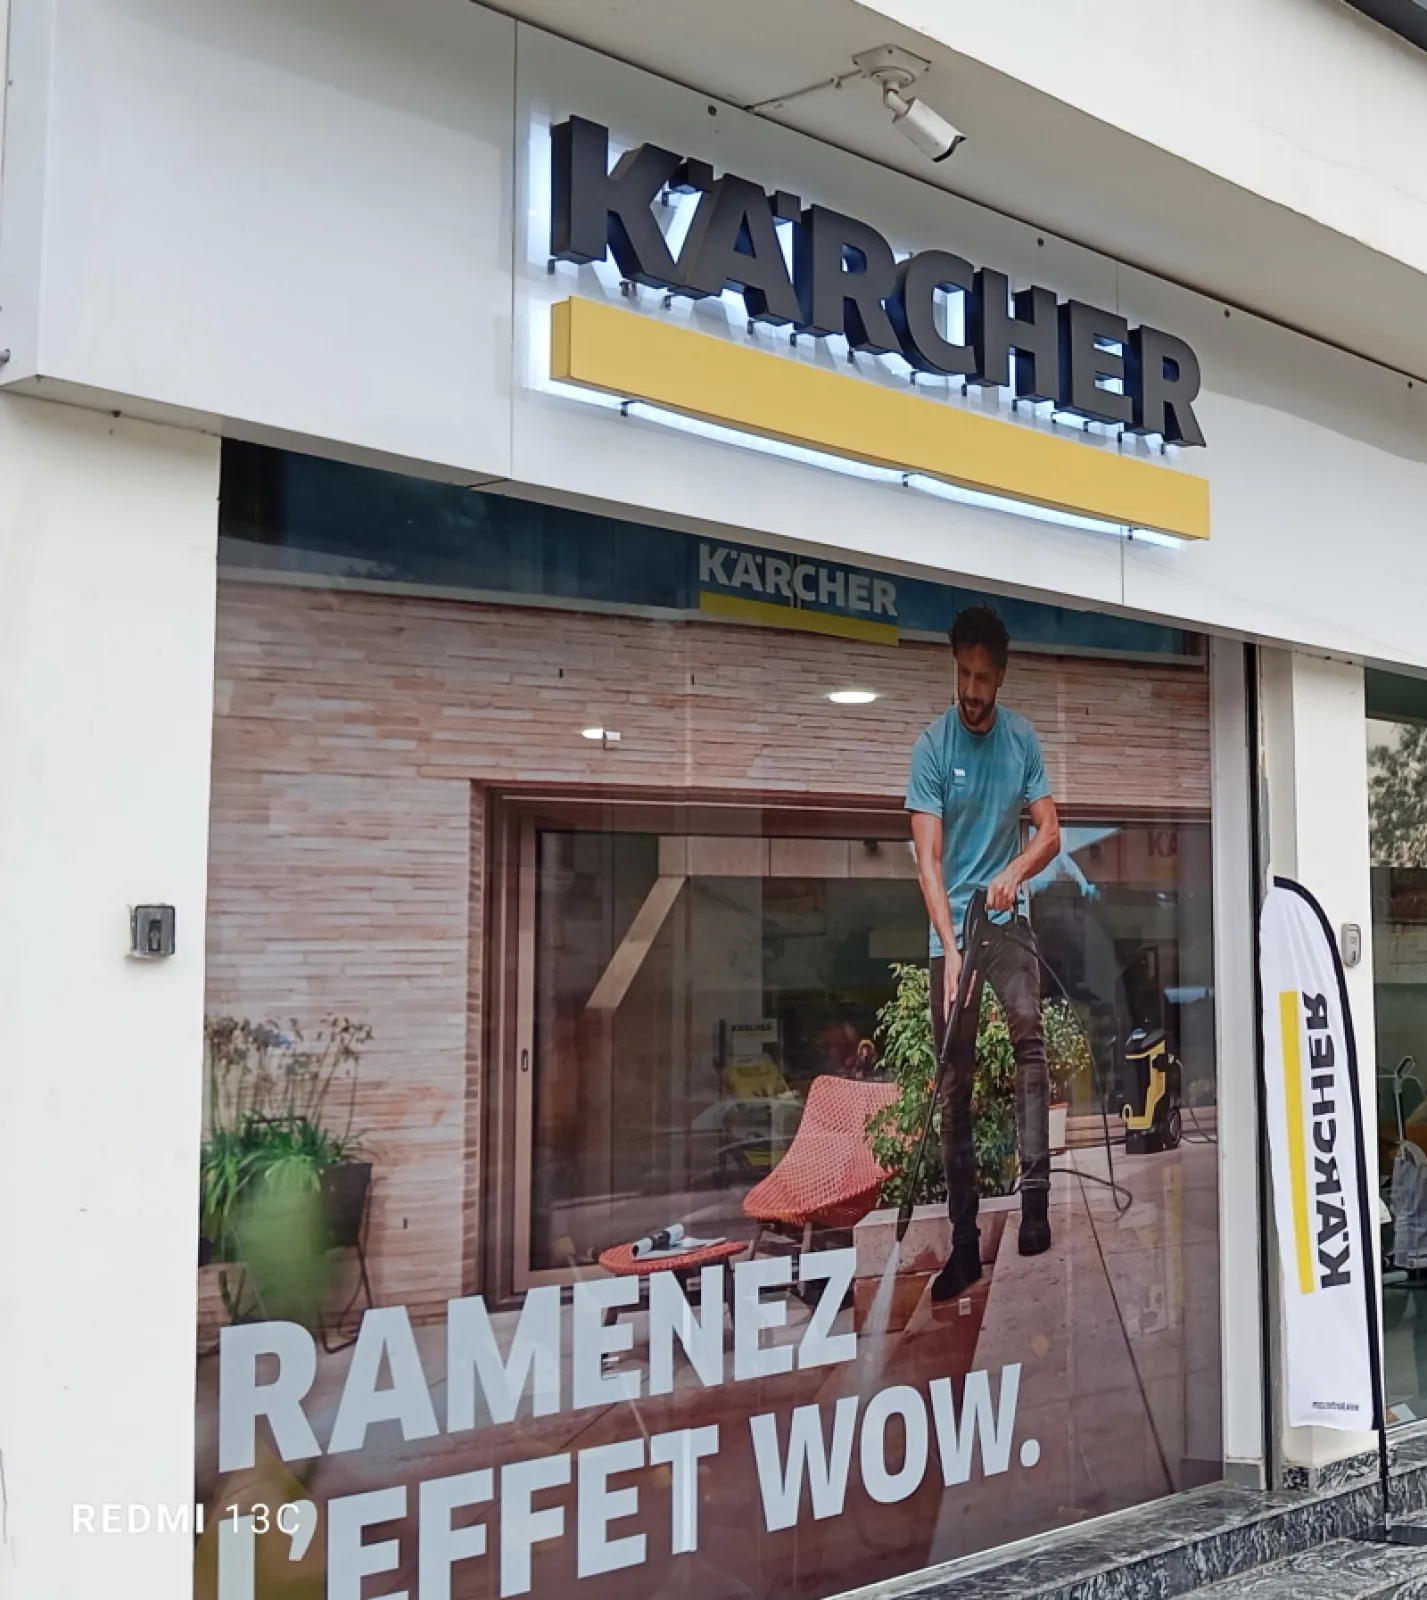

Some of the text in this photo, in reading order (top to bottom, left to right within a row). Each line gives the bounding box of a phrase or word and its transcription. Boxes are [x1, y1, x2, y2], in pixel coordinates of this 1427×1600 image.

[552, 114, 1206, 448] KÄRCHER
[699, 543, 898, 616] KÄRCHER
[218, 1248, 857, 1473] RAMENEZ
[748, 1364, 1042, 1533] WOW.
